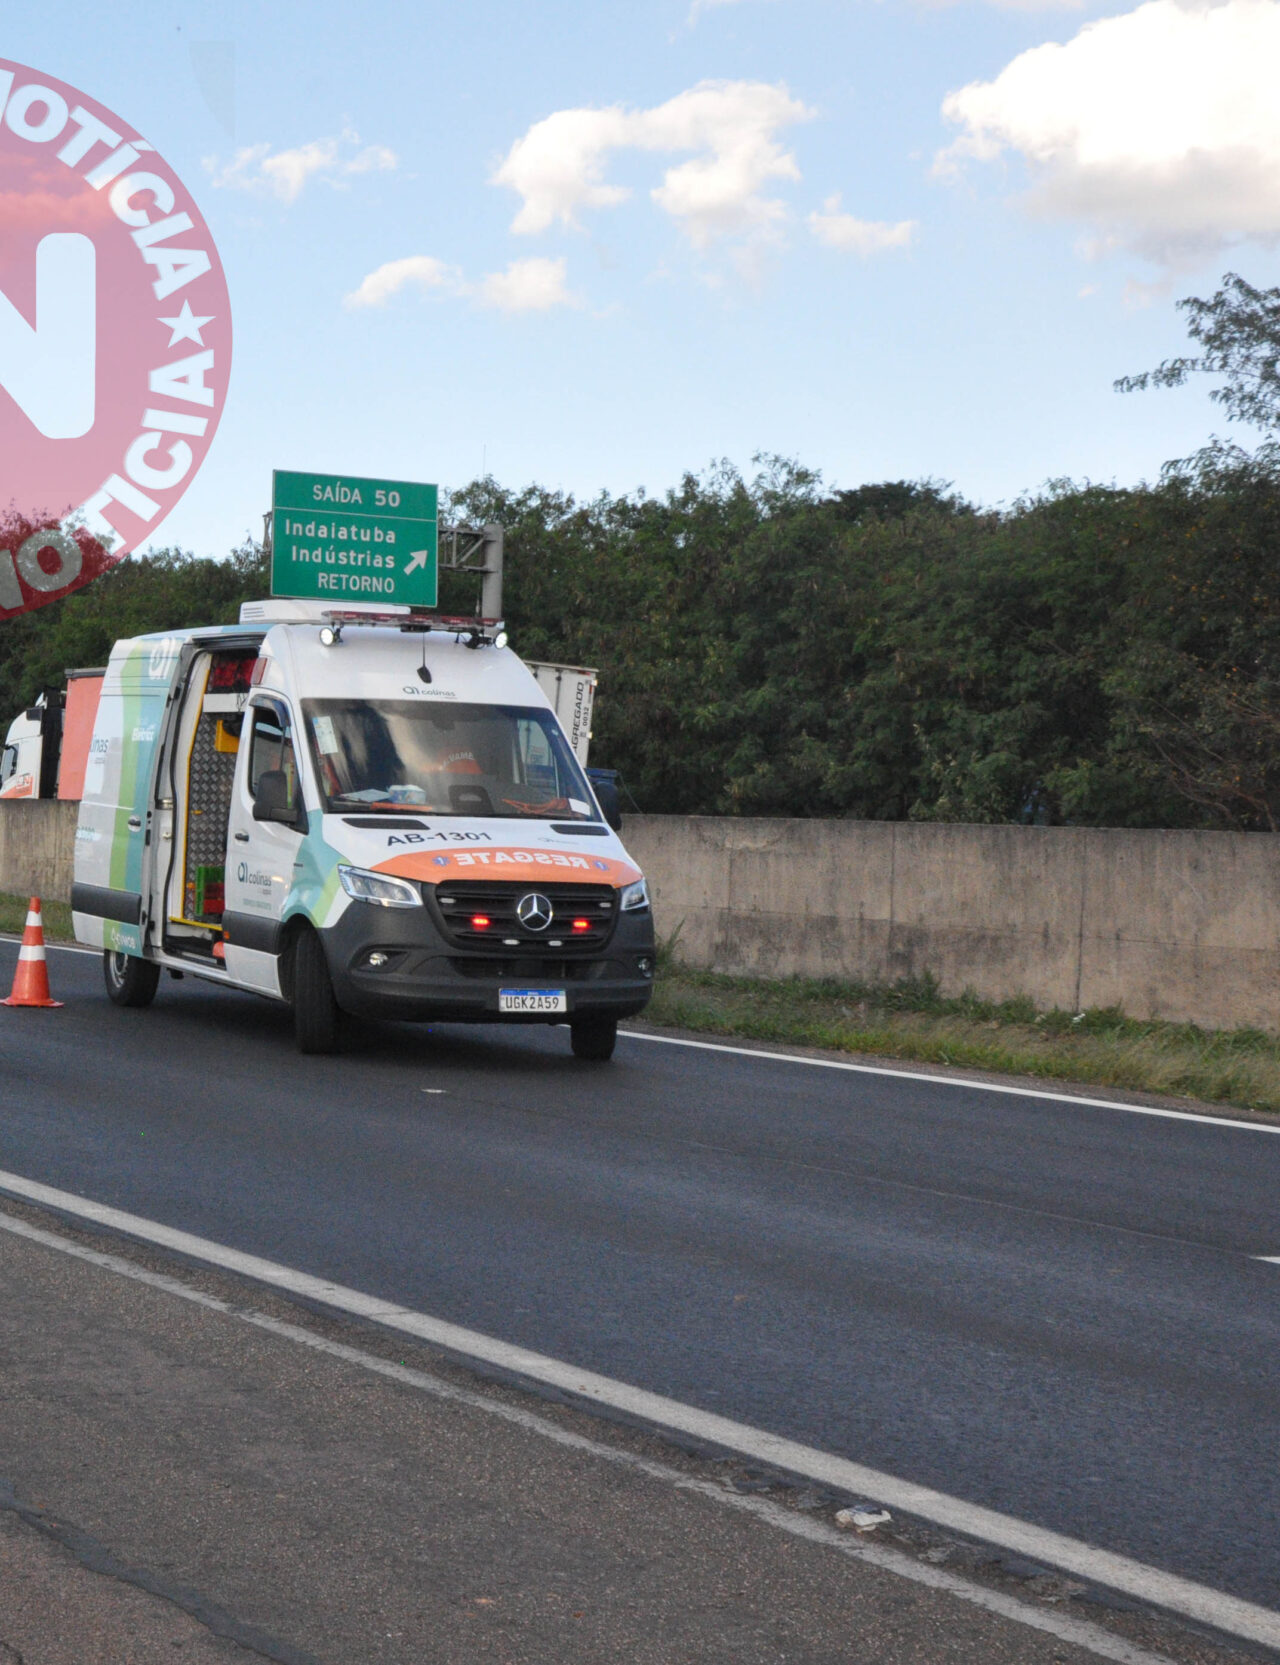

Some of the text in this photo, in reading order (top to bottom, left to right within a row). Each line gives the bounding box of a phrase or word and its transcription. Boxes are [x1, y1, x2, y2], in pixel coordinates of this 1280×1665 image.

[313, 481, 401, 508] SAÍDA 50
[285, 519, 396, 544] Indaiatuba
[291, 545, 396, 569] Indústrias
[318, 572, 395, 594] RETORNO
[386, 831, 493, 847] AB-1301
[248, 871, 272, 887] colinas
[505, 996, 560, 1010] UGK2A59
